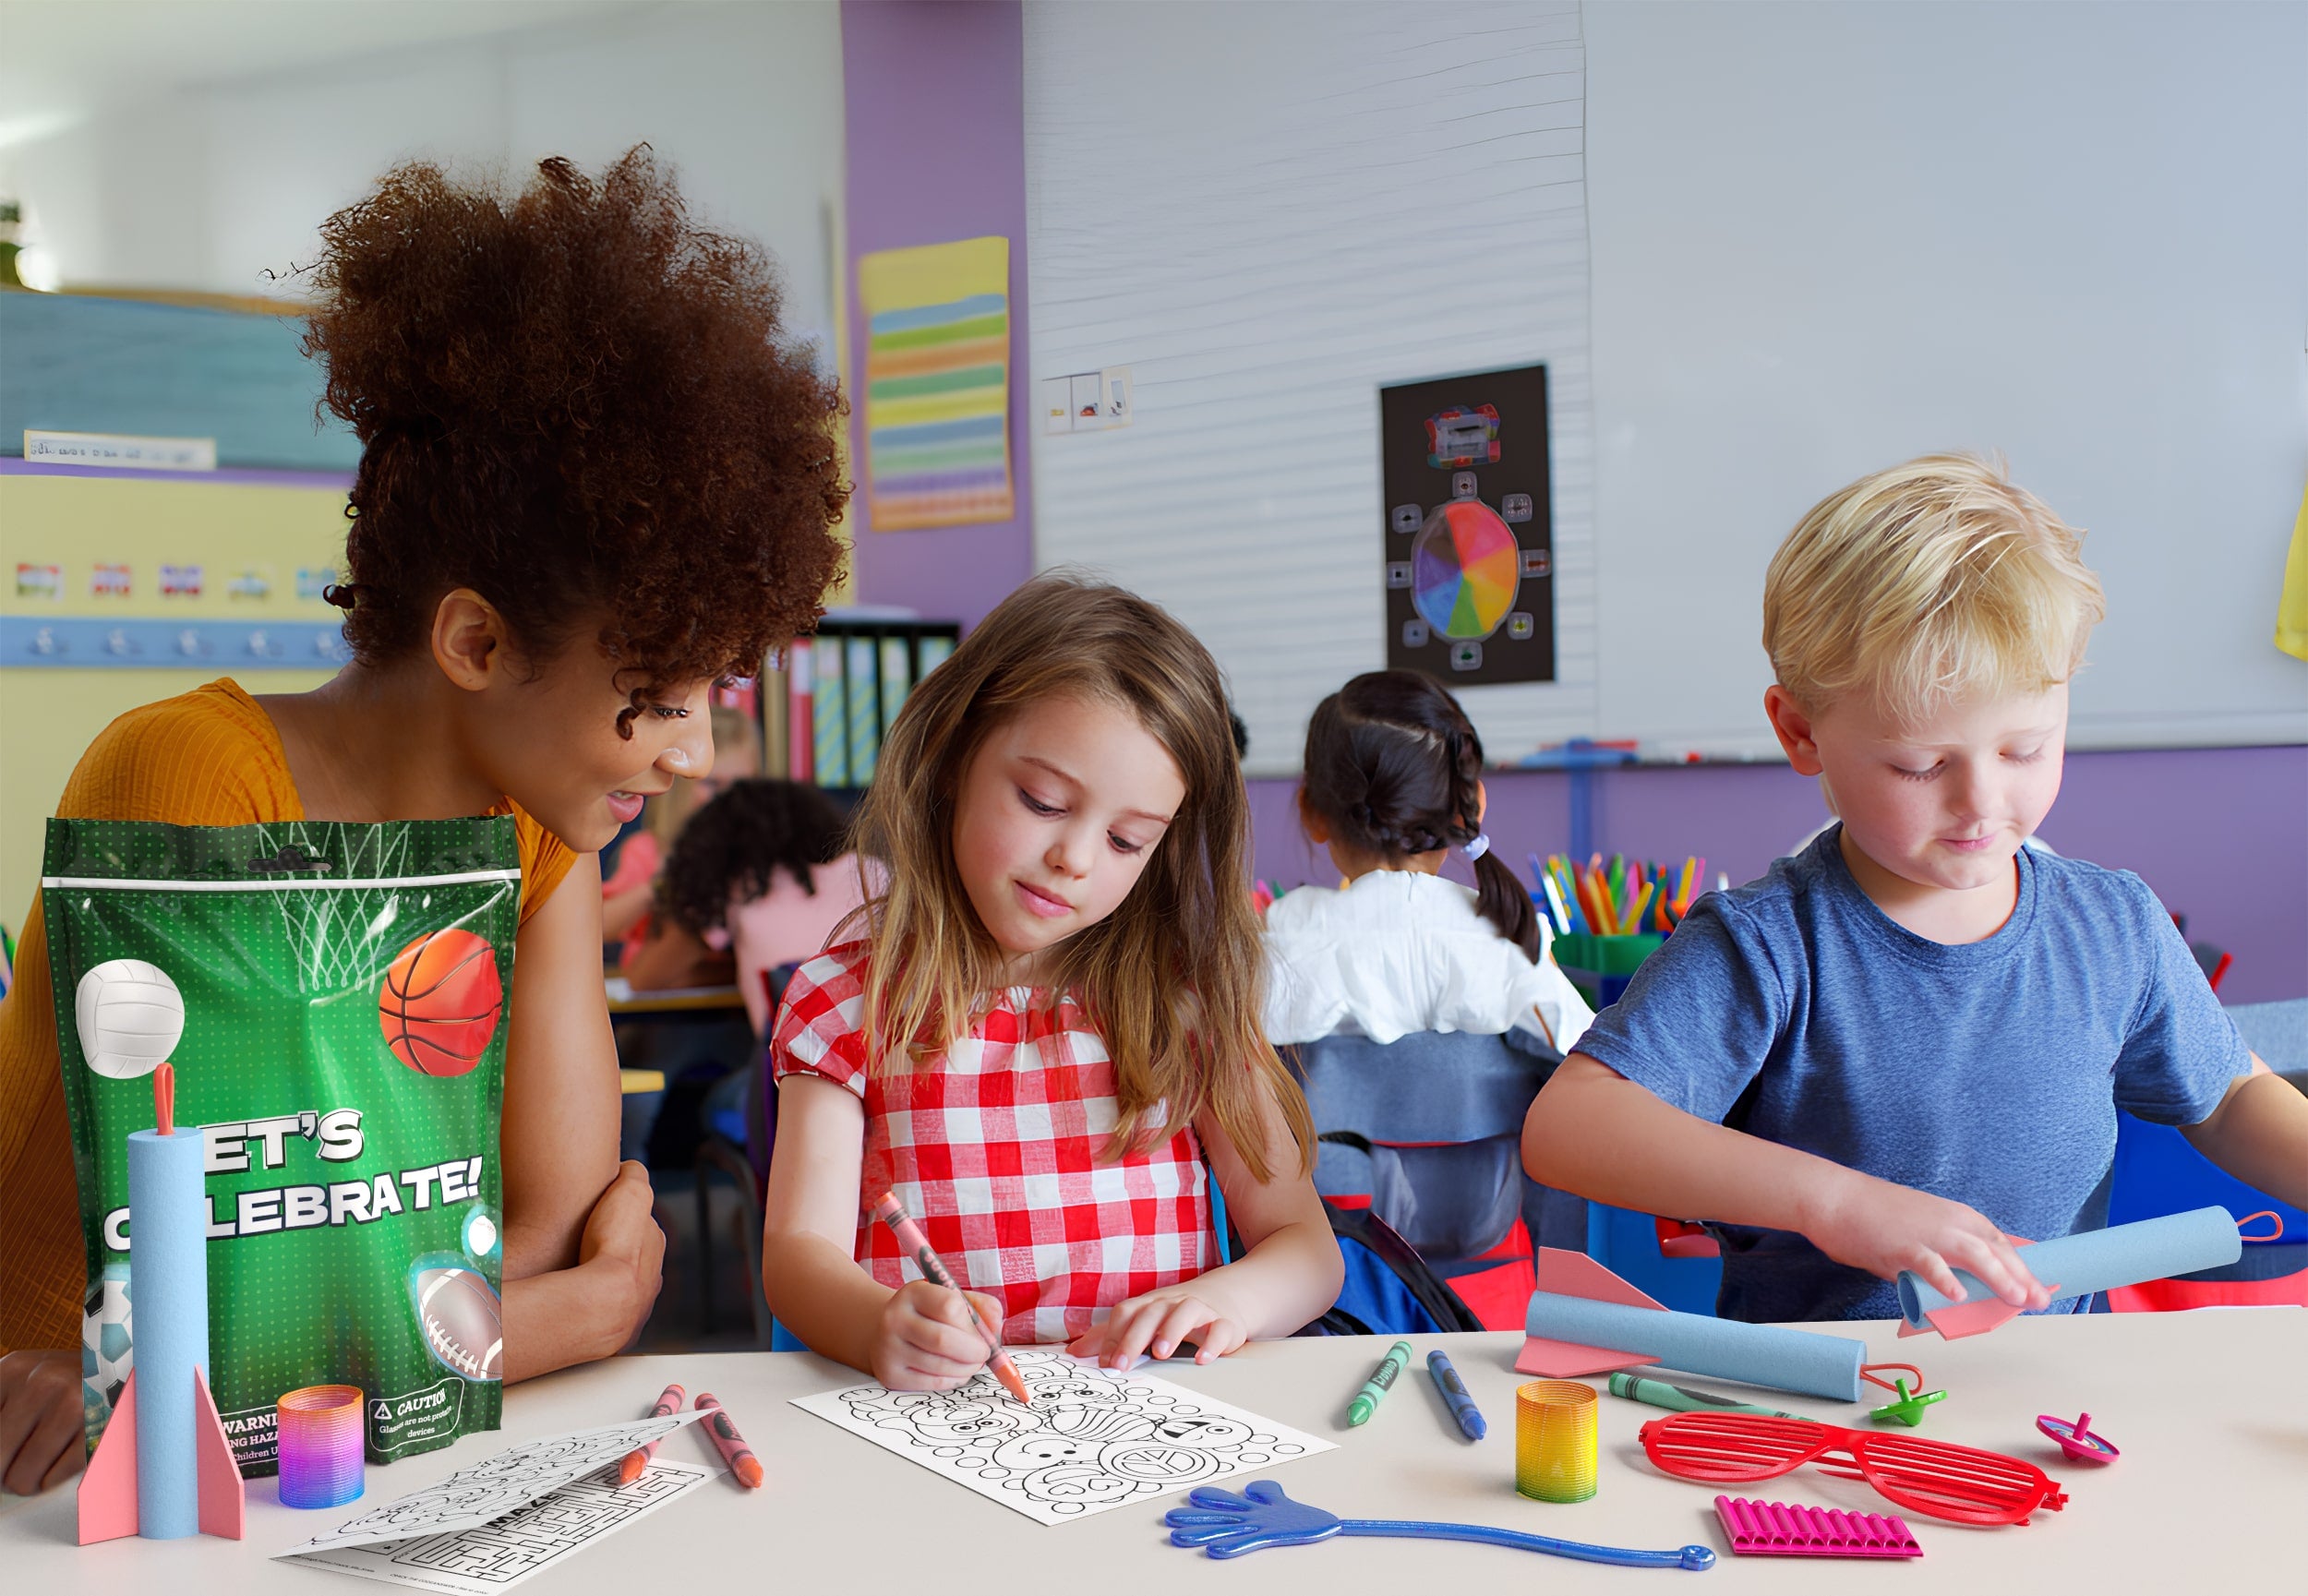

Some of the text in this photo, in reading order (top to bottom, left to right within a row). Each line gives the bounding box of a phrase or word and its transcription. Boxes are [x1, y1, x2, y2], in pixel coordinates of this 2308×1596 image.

[197, 1108, 365, 1175] ET'S
[103, 1154, 484, 1254] CLEBRATE!
[397, 1388, 446, 1416] CAUTION
[222, 1413, 278, 1434] WARNI
[418, 1415, 431, 1423] not
[407, 1427, 435, 1437] devices
